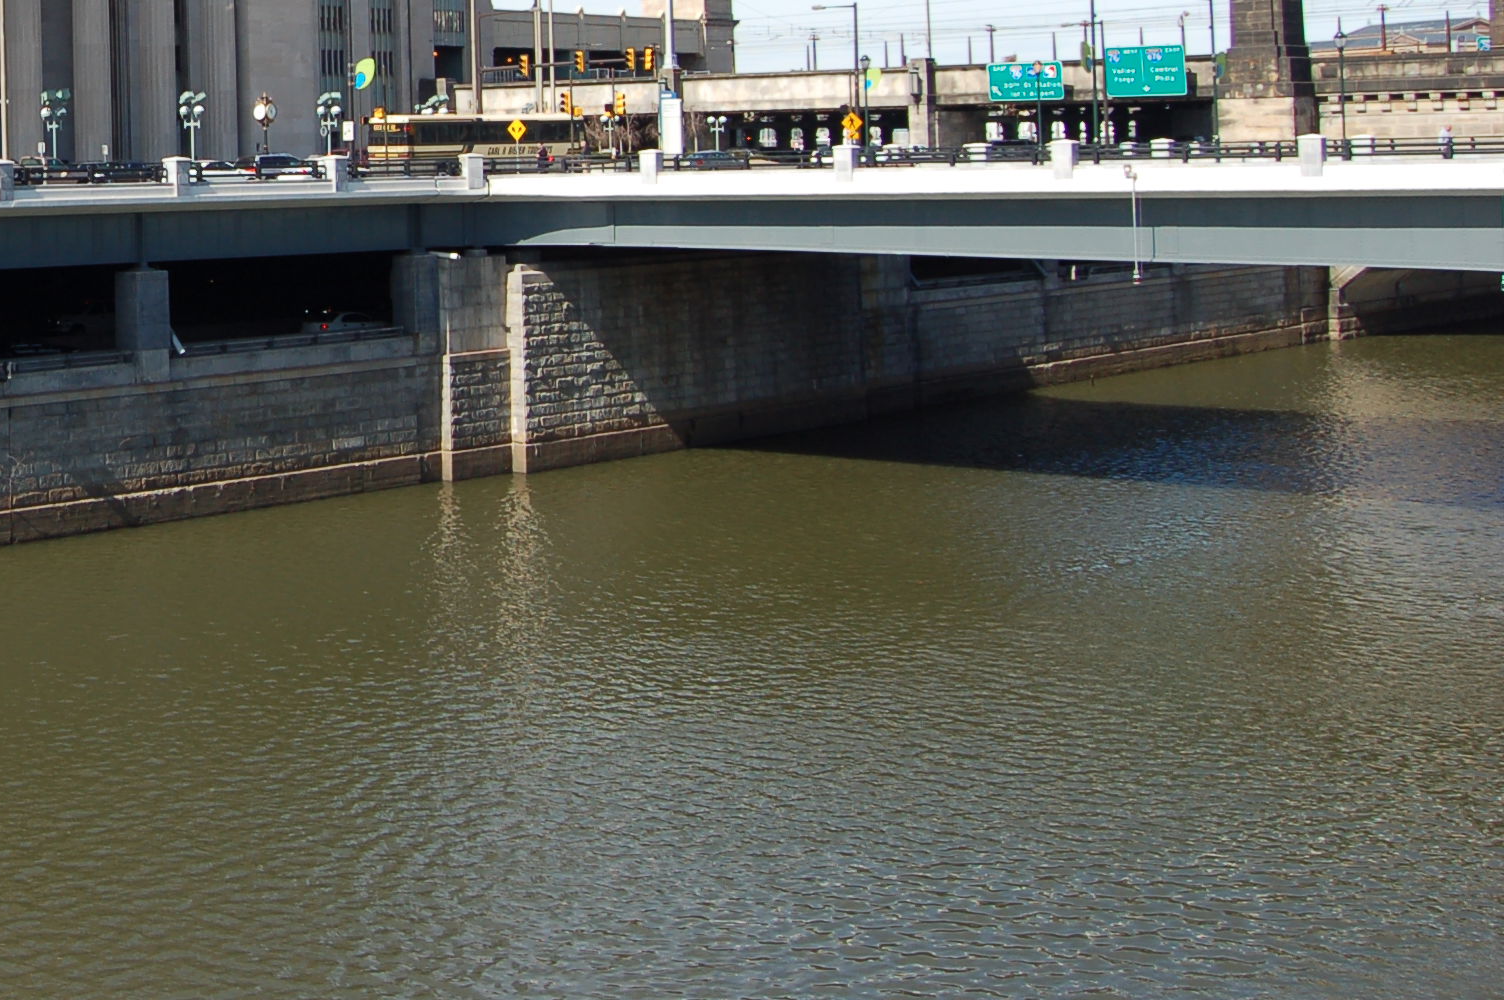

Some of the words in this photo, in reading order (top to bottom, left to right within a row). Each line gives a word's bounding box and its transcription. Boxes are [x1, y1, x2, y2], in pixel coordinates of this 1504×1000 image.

[1109, 54, 1120, 62] 76
[1147, 53, 1162, 61] 676
[488, 146, 499, 155] CARL
